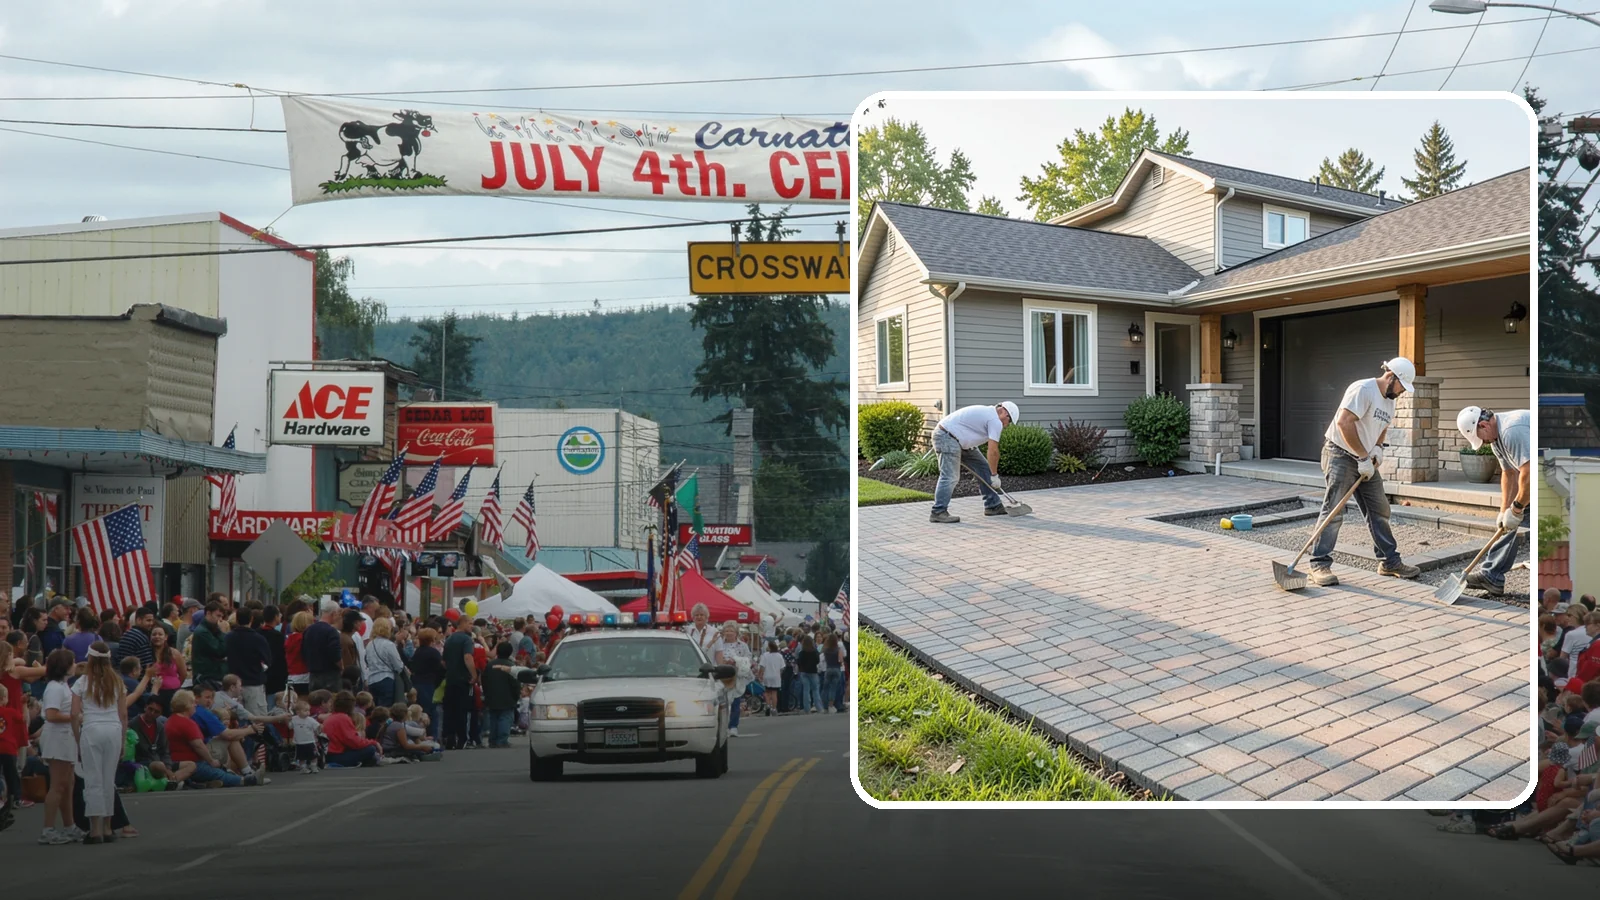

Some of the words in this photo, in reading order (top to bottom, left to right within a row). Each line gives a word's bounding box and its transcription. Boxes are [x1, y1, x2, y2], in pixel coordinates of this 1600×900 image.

[695, 121, 850, 149] Carnat
[481, 141, 604, 192] JULY
[632, 150, 746, 198] 4th.
[697, 254, 850, 279] CROSSWA
[283, 380, 373, 419] ACE
[406, 409, 452, 422] CEDAR
[283, 421, 370, 436] Hardware
[416, 428, 477, 447] Coca-Cola
[354, 467, 385, 482] Simpl
[95, 485, 124, 495] Vincent
[126, 486, 136, 495] de
[137, 486, 155, 495] Paul
[688, 526, 741, 535] CRNATION
[699, 535, 730, 543] GLASS
